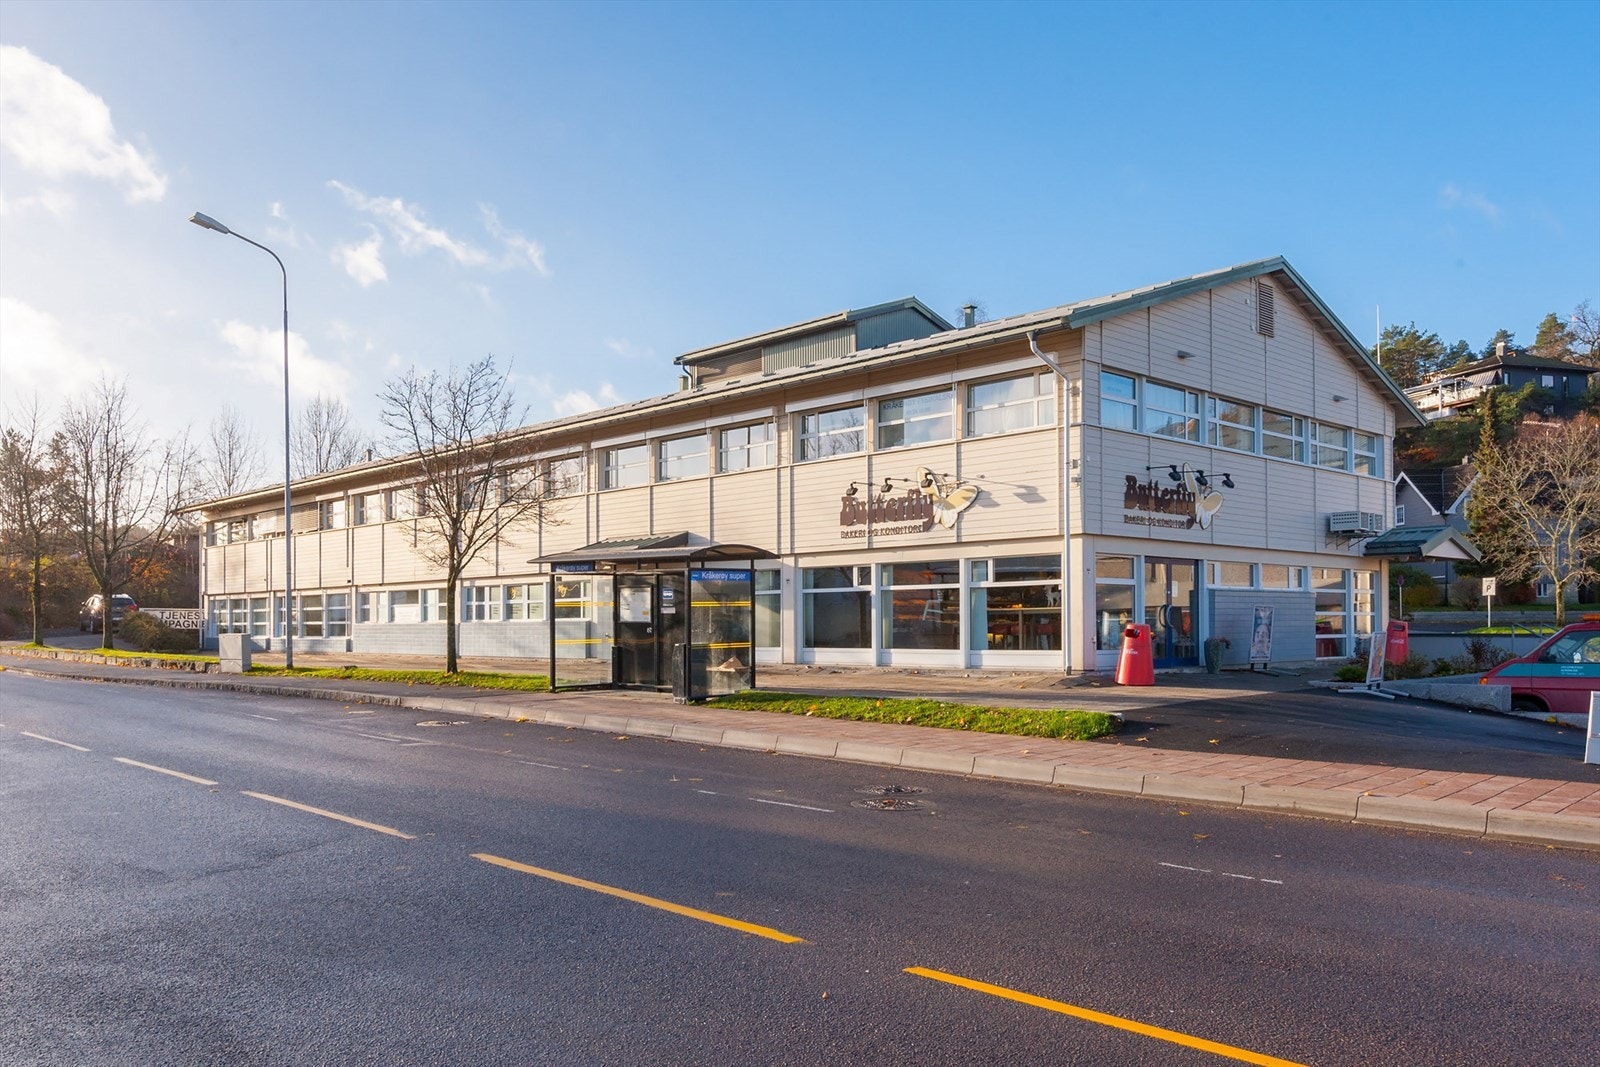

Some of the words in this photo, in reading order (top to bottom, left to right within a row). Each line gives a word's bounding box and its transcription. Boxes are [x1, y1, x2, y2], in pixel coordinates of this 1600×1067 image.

[839, 489, 934, 533] Butterfly
[1124, 475, 1196, 530] Butterfly
[701, 570, 729, 580] Kråkerøy
[729, 572, 747, 580] super
